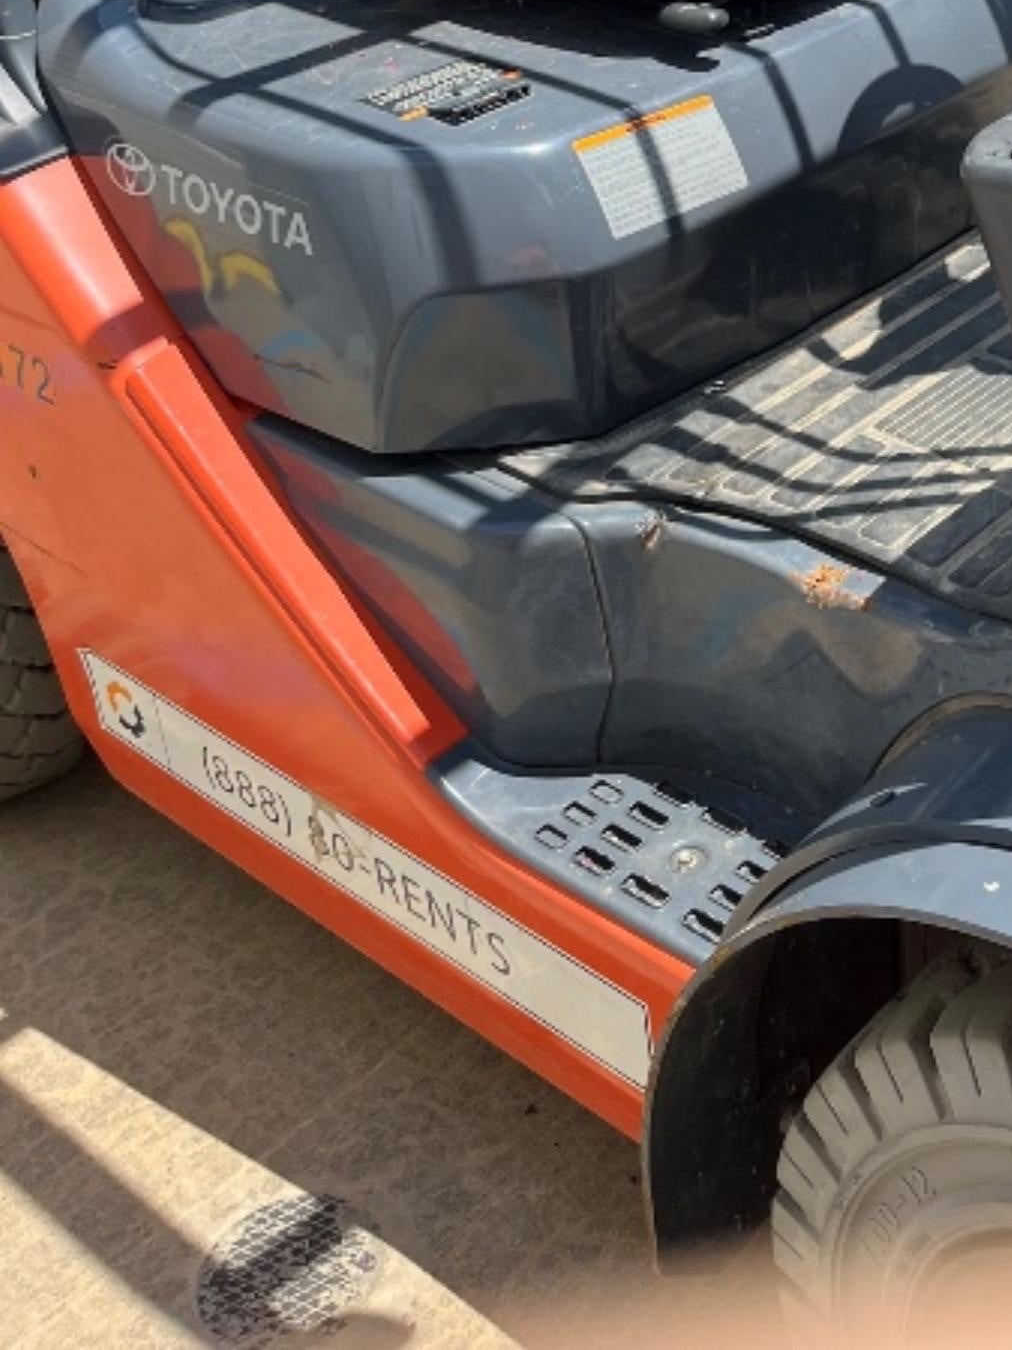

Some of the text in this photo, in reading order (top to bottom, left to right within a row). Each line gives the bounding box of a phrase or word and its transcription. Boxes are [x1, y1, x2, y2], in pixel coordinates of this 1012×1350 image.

[161, 163, 313, 256] TOYOTA
[0, 340, 55, 407] 72
[201, 744, 293, 838] (888)
